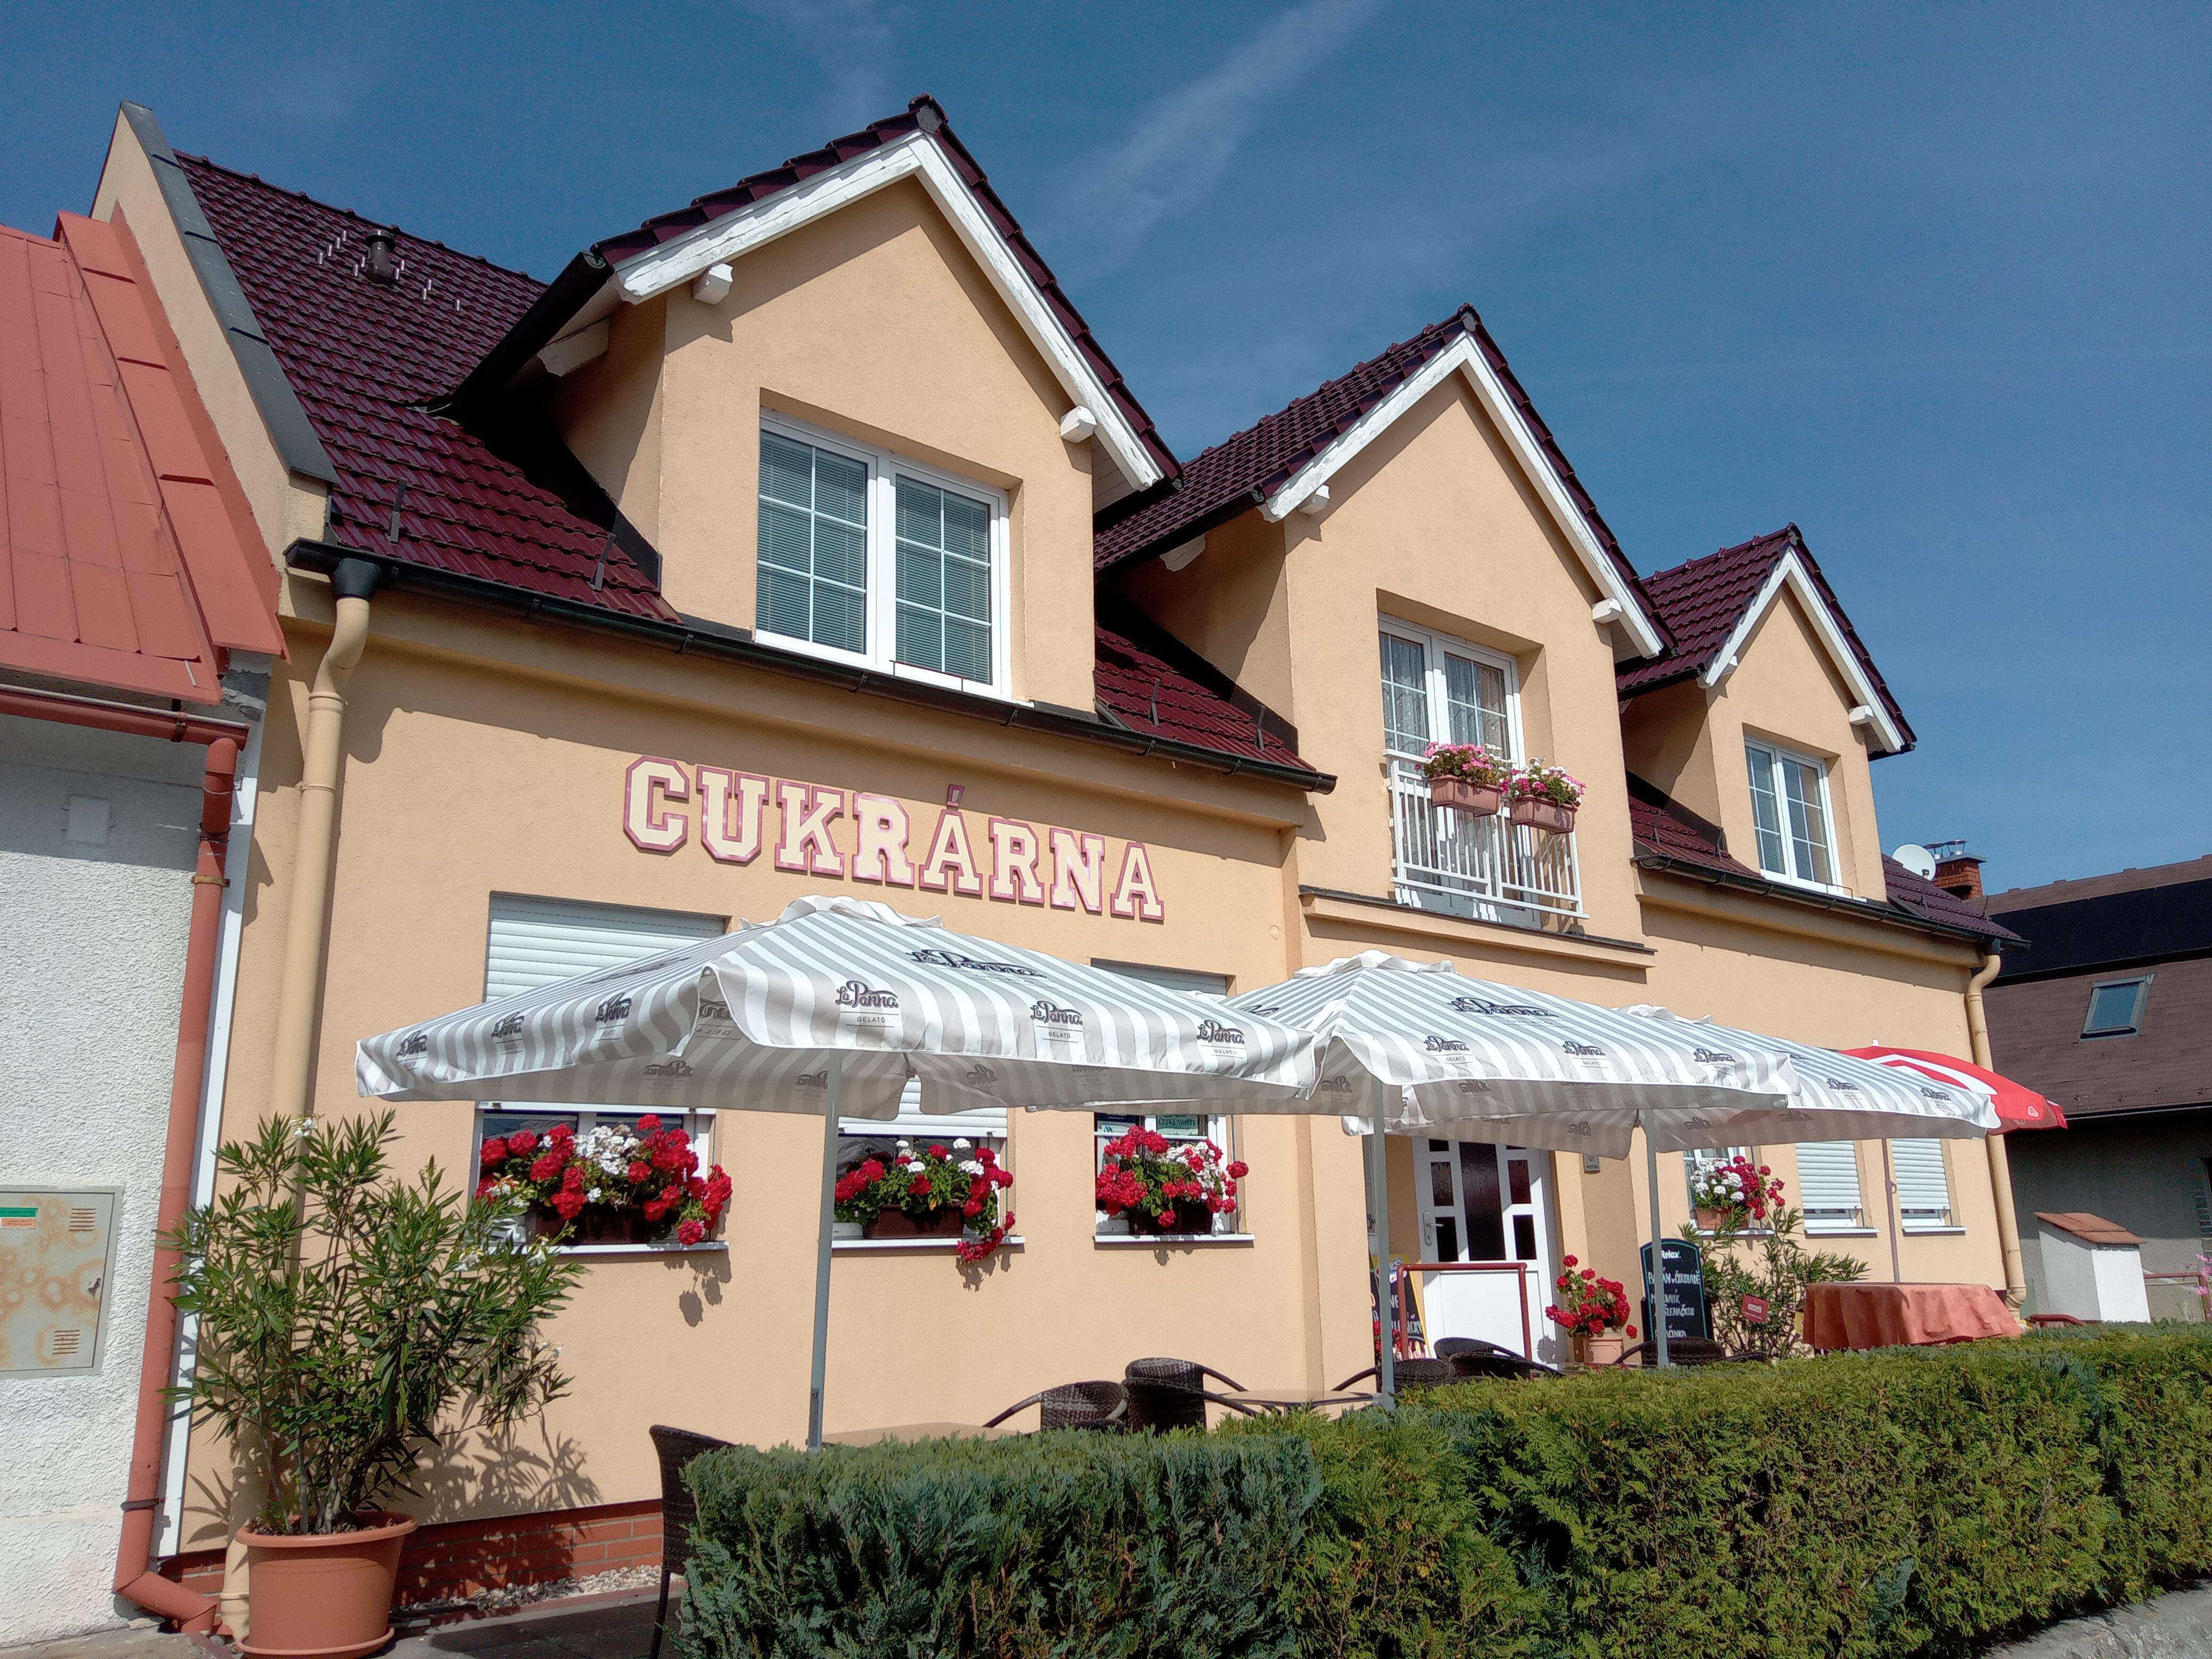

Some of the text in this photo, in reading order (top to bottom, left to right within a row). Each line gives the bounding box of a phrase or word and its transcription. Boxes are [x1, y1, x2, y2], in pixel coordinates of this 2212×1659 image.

[623, 755, 1165, 921] CUKRÁRNA
[920, 950, 1047, 978] Panna
[835, 980, 899, 1008] La Panna
[1037, 1000, 1083, 1025] Panna
[1204, 1020, 1245, 1045] Panna
[1427, 1036, 1470, 1052] Panna
